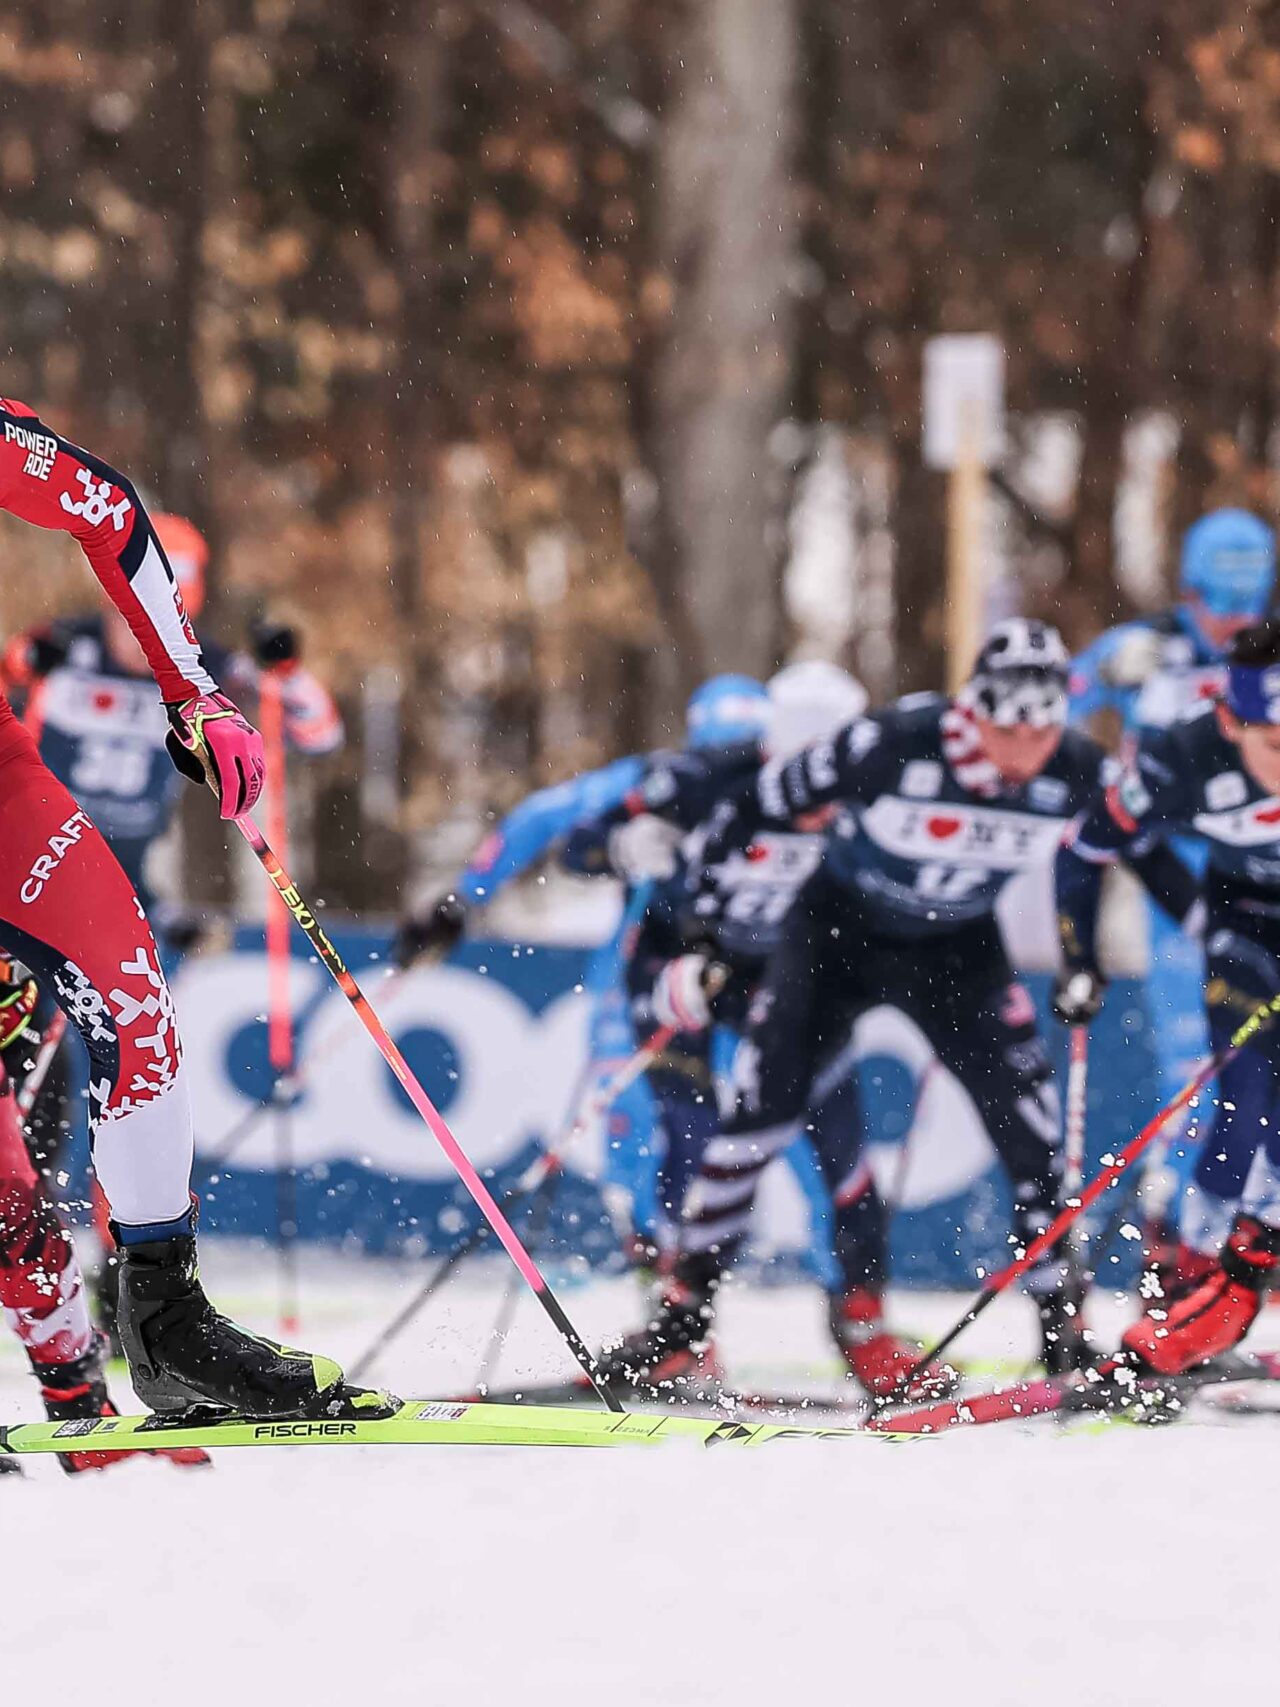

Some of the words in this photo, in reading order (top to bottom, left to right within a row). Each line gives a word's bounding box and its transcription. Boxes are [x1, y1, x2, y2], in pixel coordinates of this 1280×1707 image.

[4, 421, 58, 460] POWER
[23, 454, 55, 481] ADE
[20, 810, 94, 904] CRAFT
[254, 1422, 357, 1439] FISCHER
